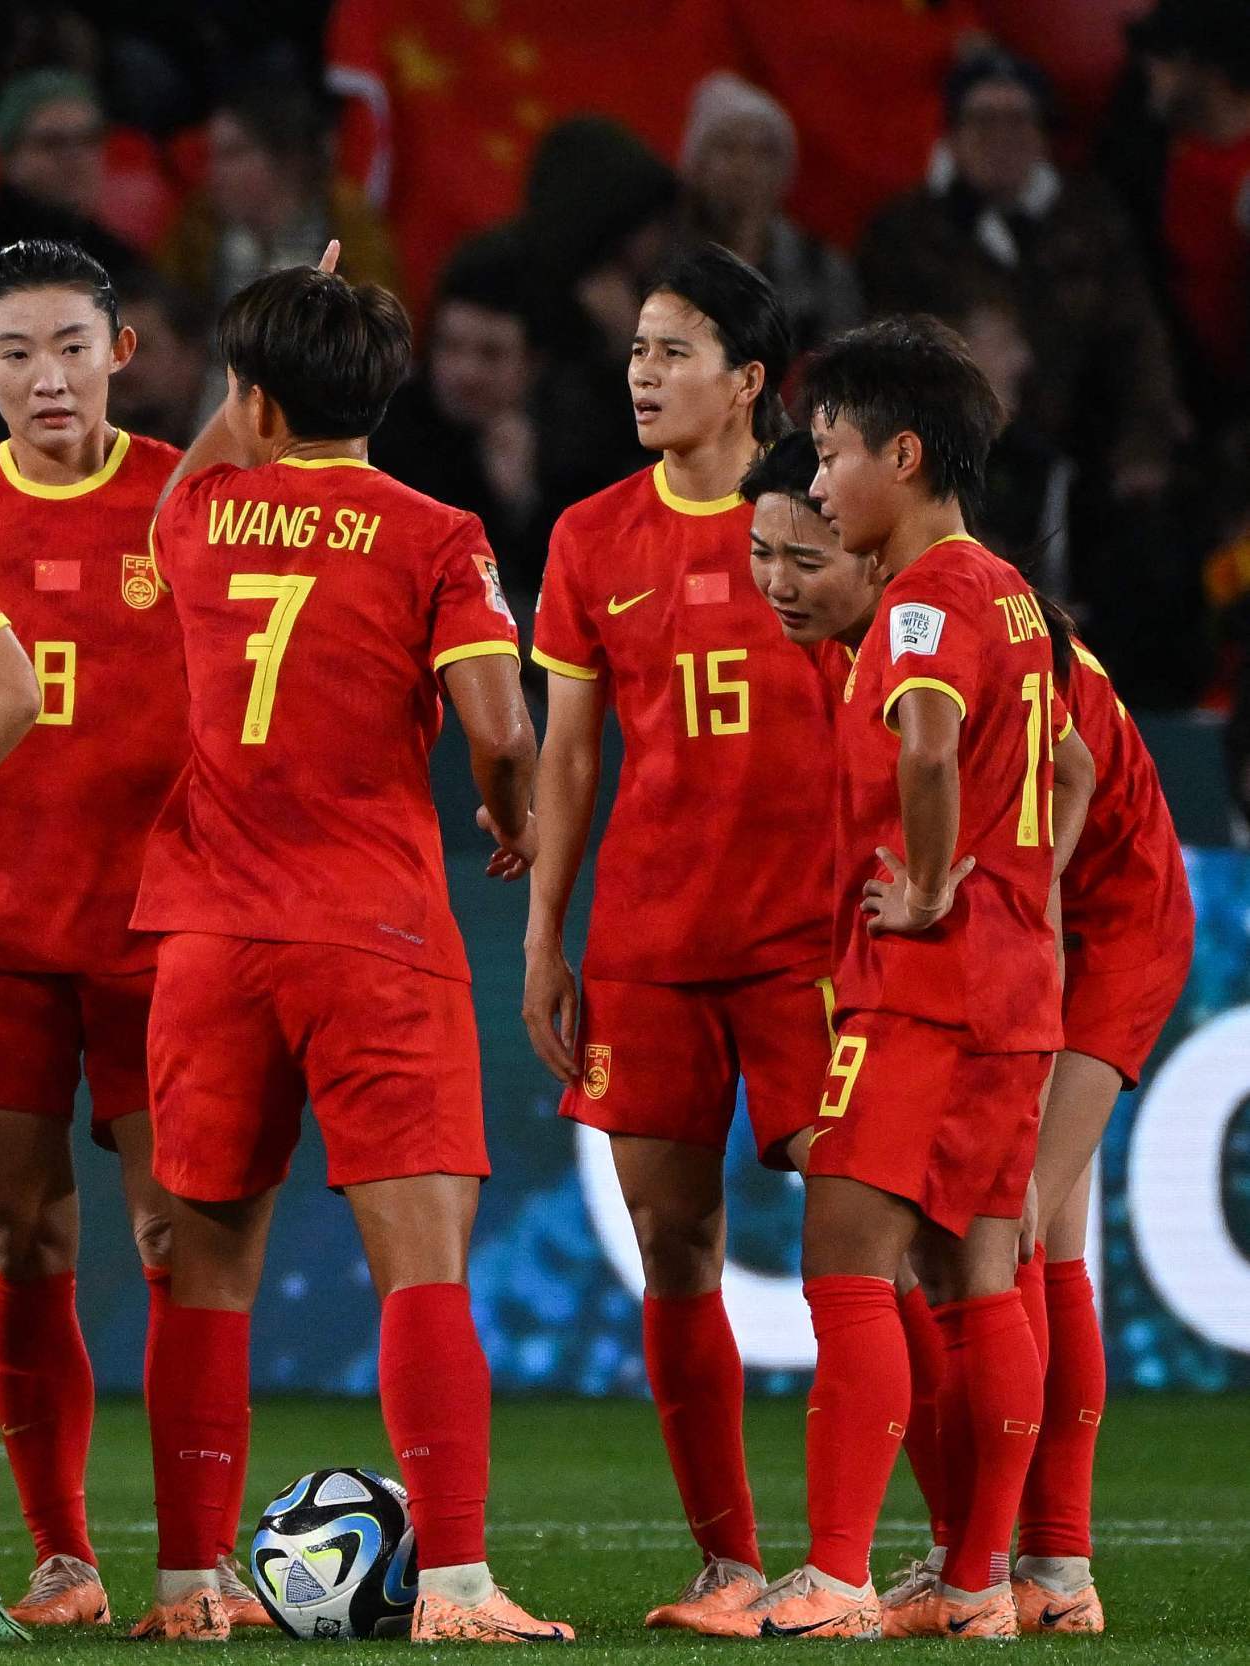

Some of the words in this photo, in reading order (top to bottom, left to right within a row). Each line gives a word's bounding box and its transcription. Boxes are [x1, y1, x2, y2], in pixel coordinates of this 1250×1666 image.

[208, 499, 321, 548] WANG
[327, 508, 381, 554] SH
[900, 611, 930, 622] OOTBALL
[901, 617, 930, 631] NITES
[34, 641, 76, 725] 8
[228, 574, 317, 744] 7
[676, 648, 749, 737] 15
[1016, 671, 1054, 847] 1
[588, 1048, 609, 1059] CFA
[818, 1036, 867, 1117] 9
[180, 1450, 231, 1464] CFA
